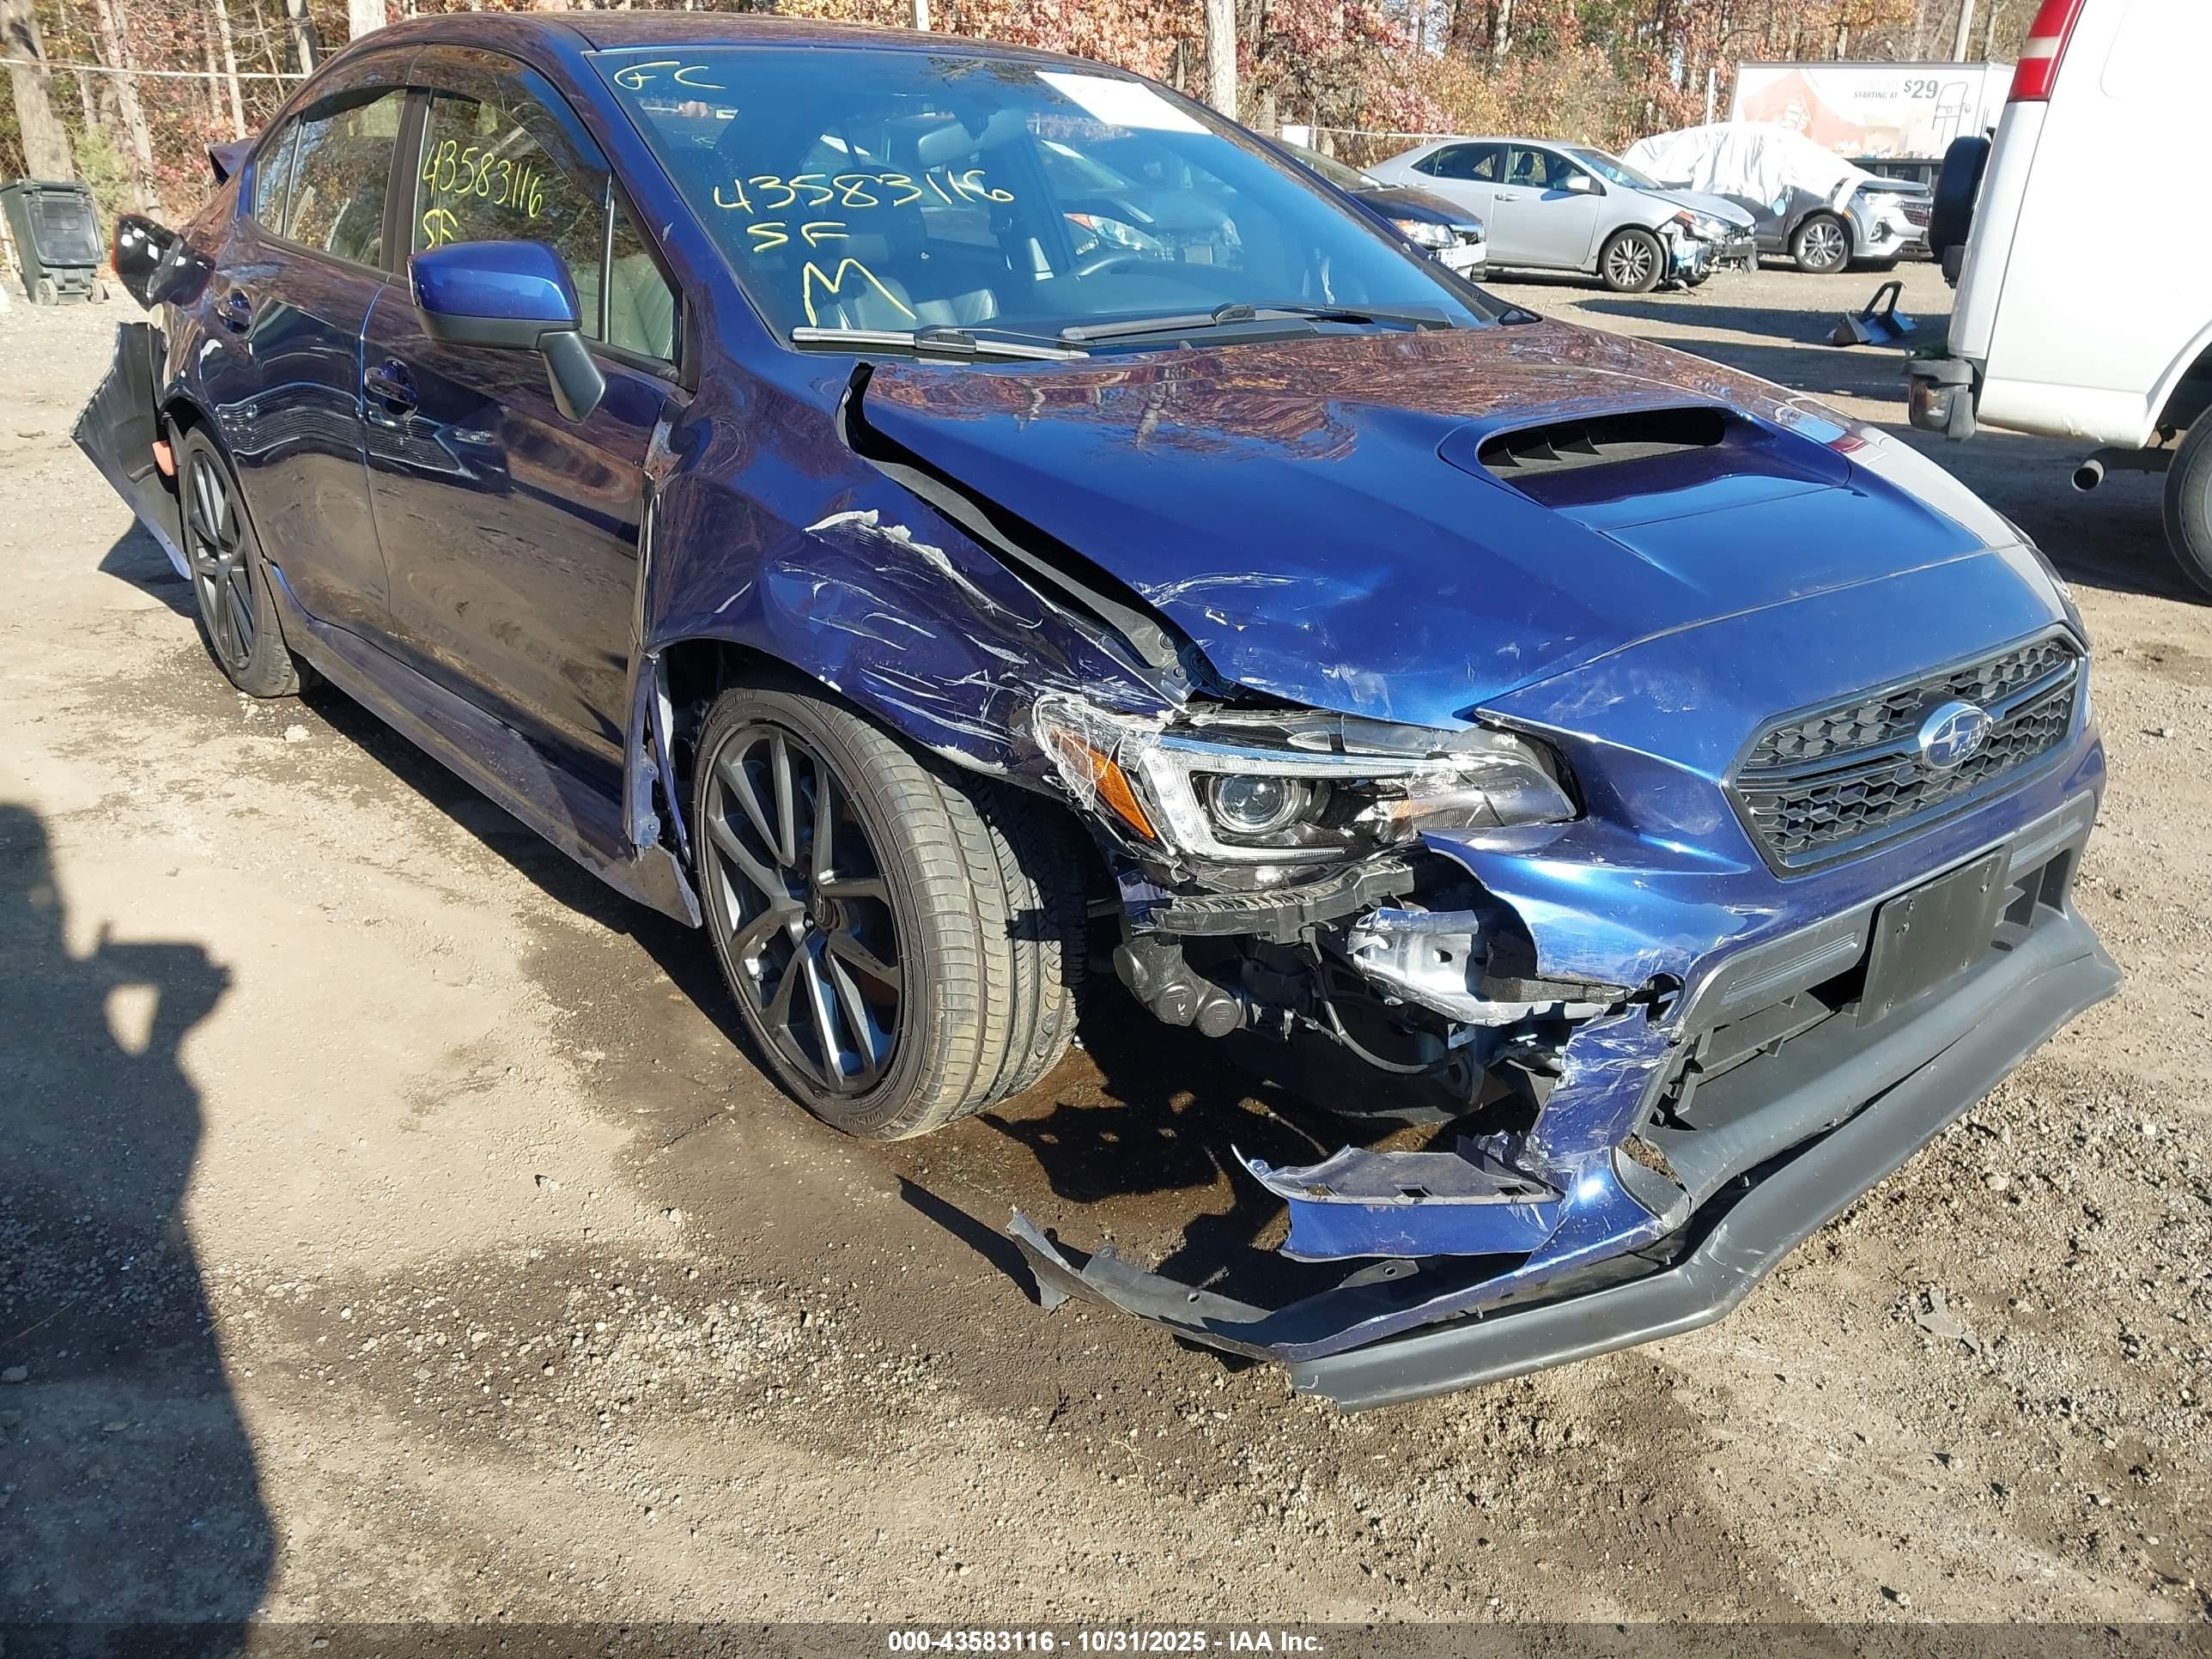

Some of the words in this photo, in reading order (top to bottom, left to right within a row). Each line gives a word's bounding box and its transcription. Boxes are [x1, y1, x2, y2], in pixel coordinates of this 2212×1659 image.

[1853, 91, 1887, 100] STARTING
[1889, 91, 1899, 100] AT
[1903, 79, 1939, 100] $29
[422, 140, 545, 218] 43583116
[713, 170, 1015, 215] 43583116
[802, 258, 917, 327] M
